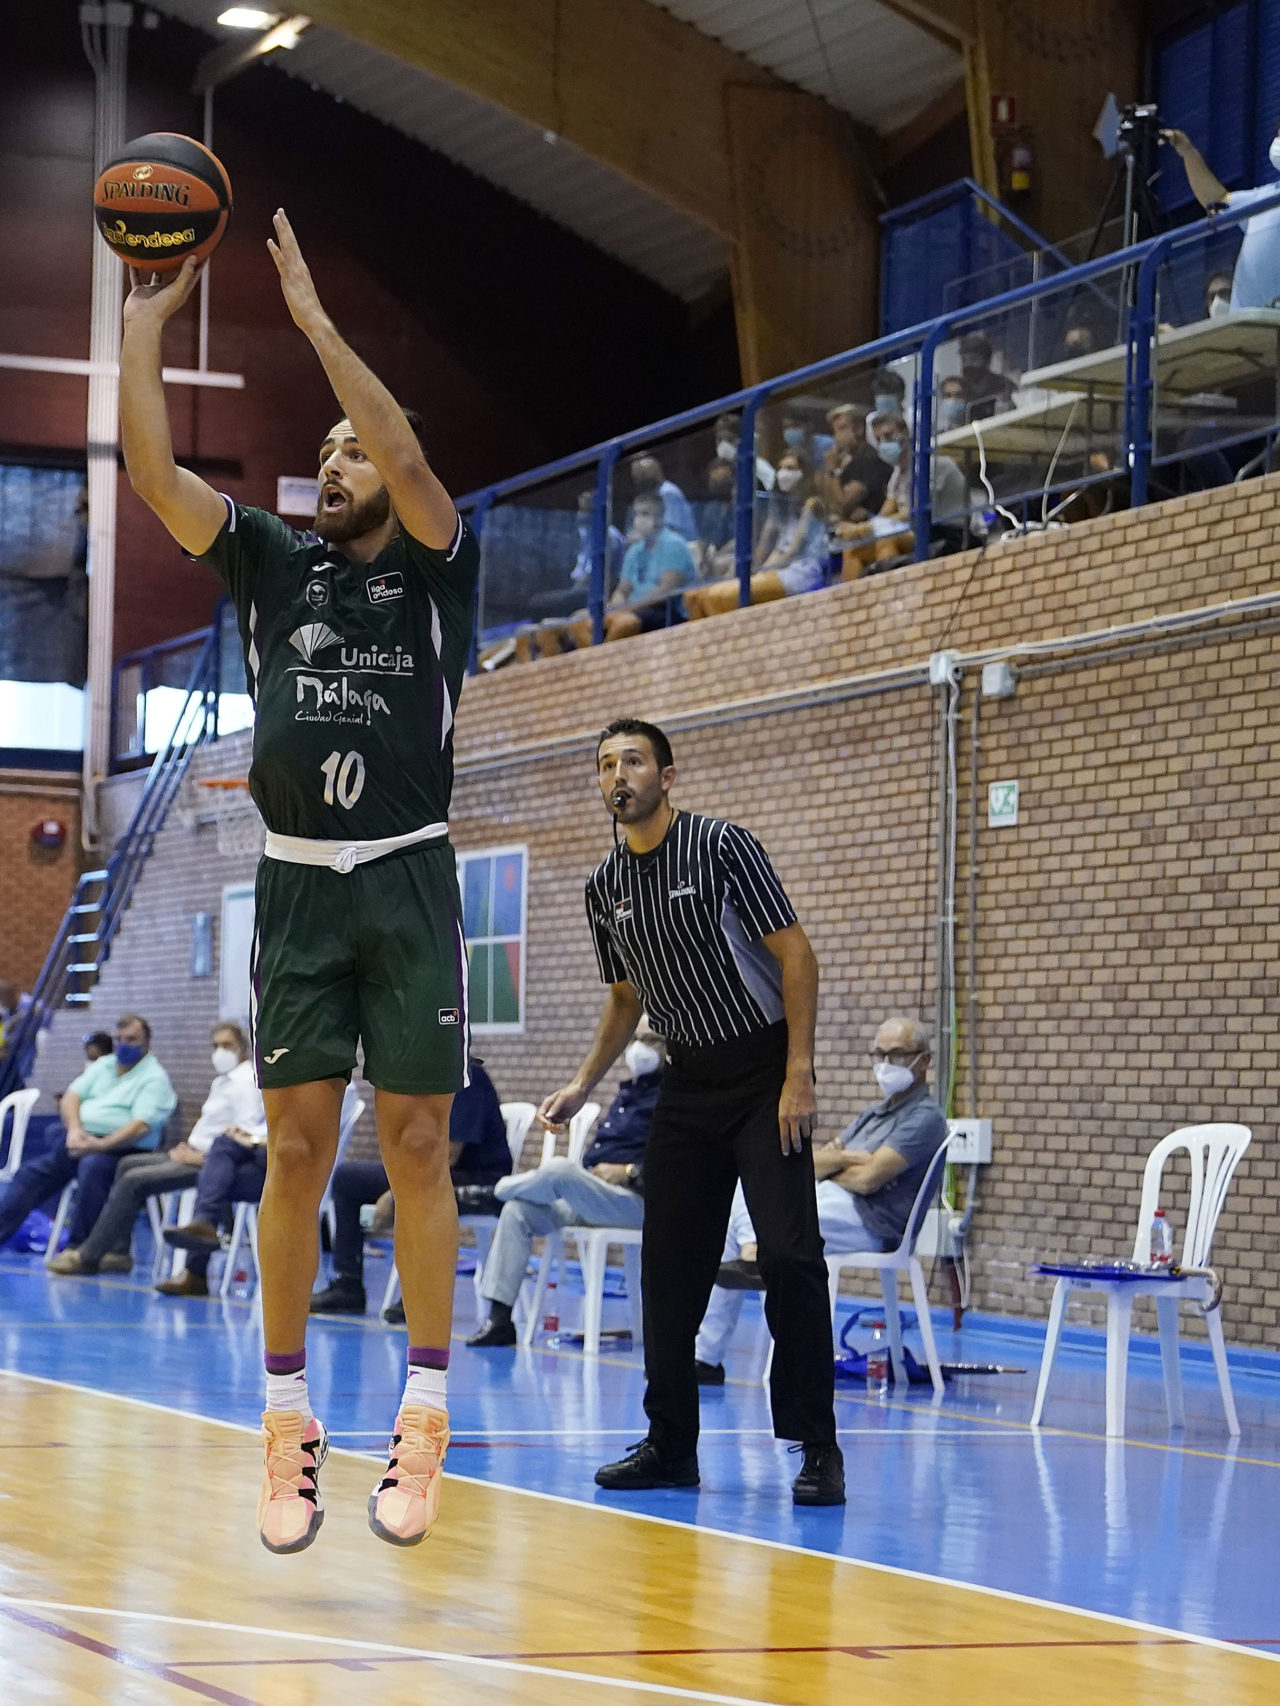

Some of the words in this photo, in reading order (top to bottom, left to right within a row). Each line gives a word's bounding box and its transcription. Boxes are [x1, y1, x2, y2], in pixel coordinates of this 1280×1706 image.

[102, 180, 192, 208] SPALDING
[125, 227, 196, 249] endesa
[340, 645, 415, 672] Unicaja
[296, 675, 391, 726] Málaga
[294, 710, 332, 722] Ciudad
[333, 711, 364, 725] Genial
[320, 750, 366, 810] 10
[441, 1014, 456, 1023] acb
